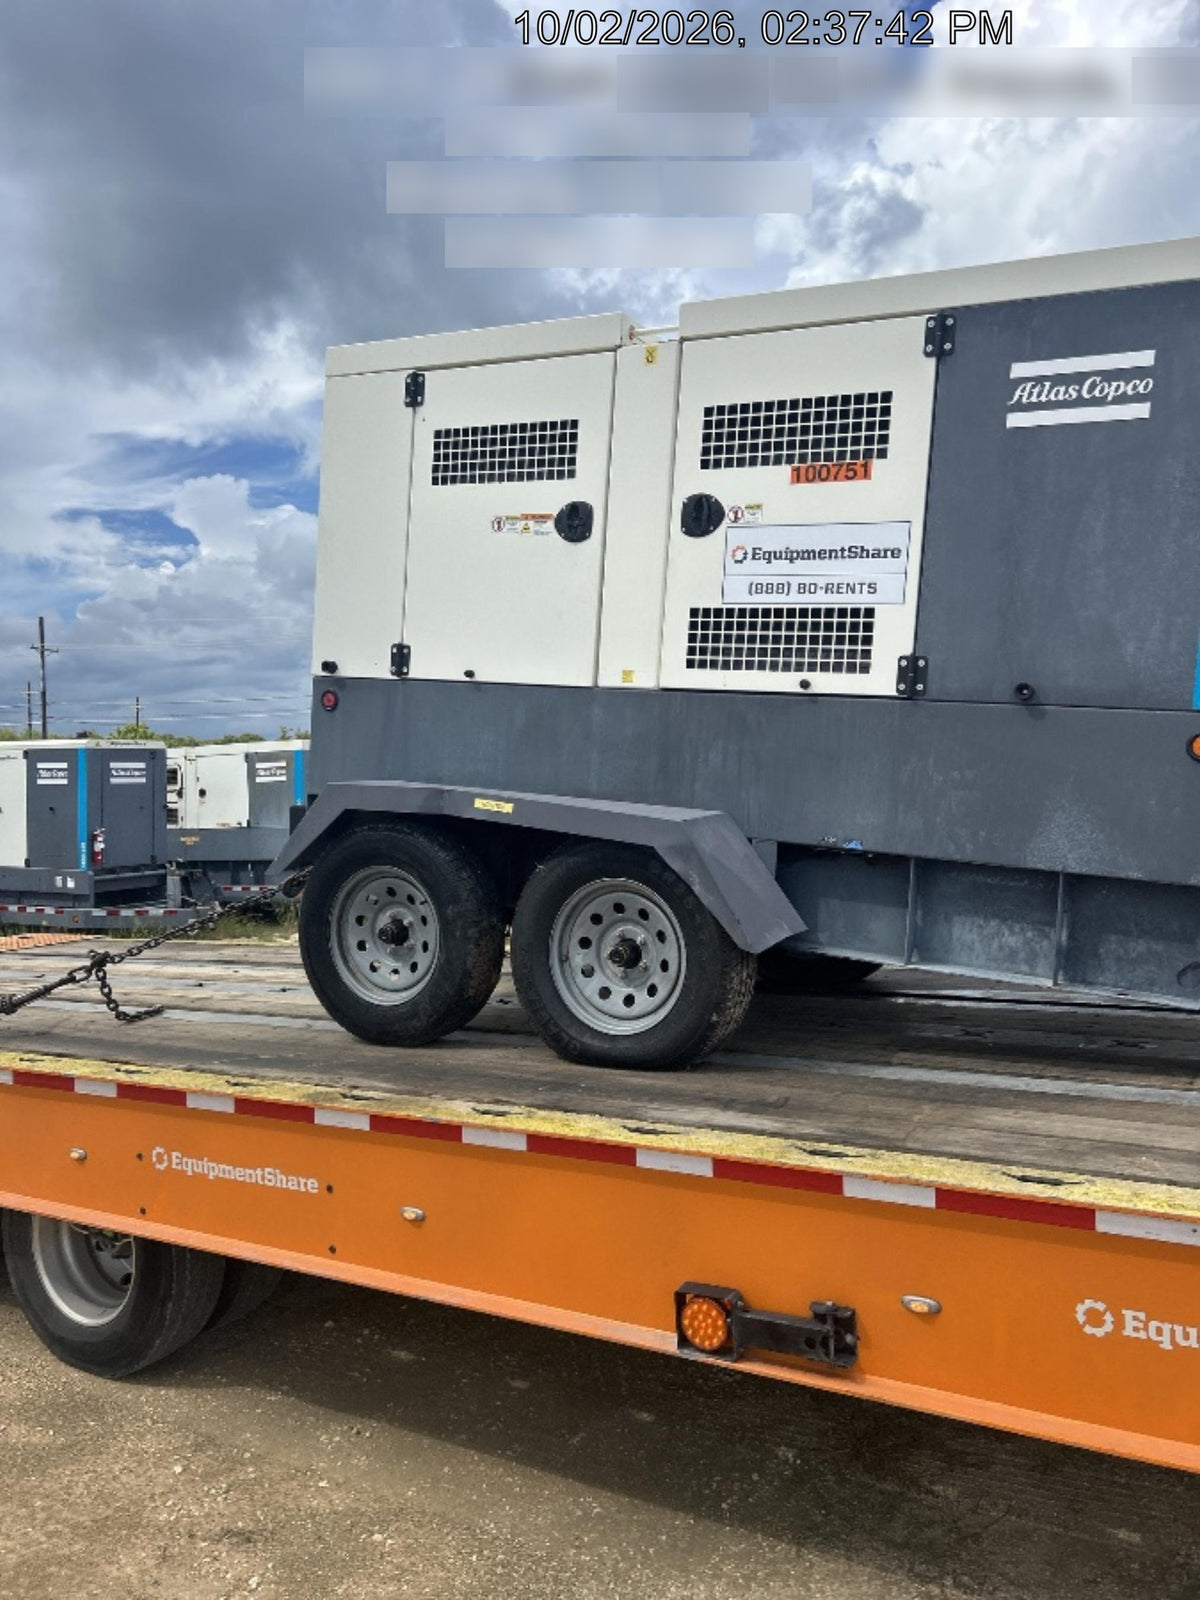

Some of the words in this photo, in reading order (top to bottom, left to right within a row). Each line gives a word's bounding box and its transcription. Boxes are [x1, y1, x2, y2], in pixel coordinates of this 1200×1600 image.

[1006, 381, 1079, 405] Atlas
[1081, 376, 1153, 402] Copco
[791, 461, 869, 483] 100751
[751, 545, 902, 564] EquipmentShare
[748, 580, 791, 596] (888)
[171, 1151, 319, 1194] EquipmentShare
